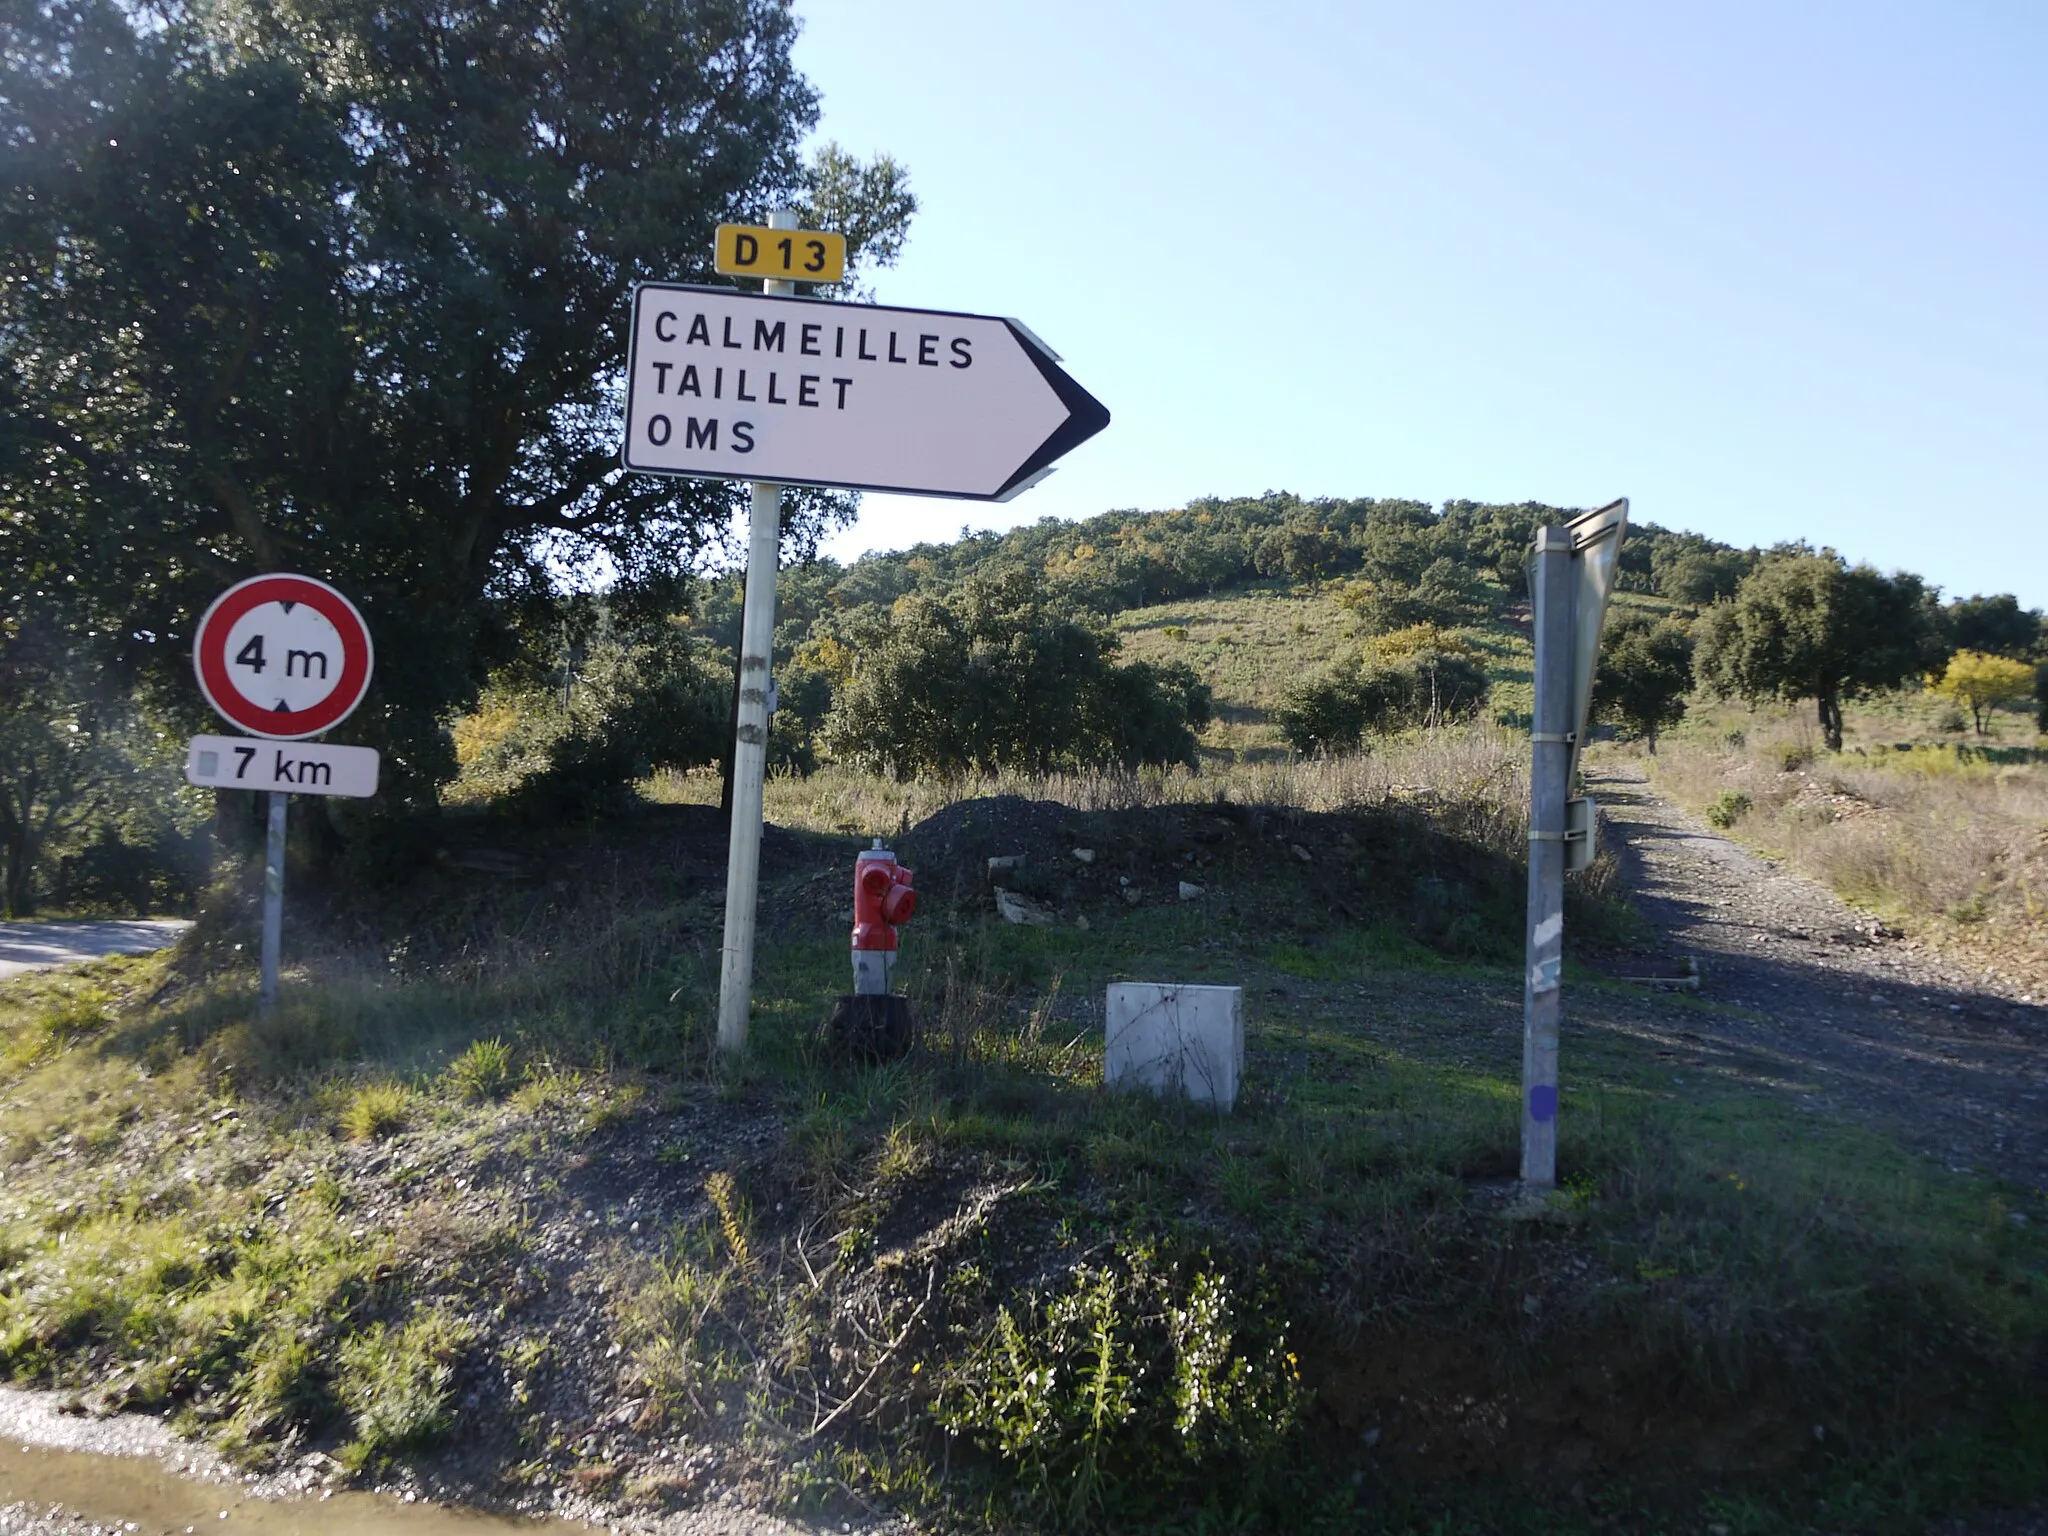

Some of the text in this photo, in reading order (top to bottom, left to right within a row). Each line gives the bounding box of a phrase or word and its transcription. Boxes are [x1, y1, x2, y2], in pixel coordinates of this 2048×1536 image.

[735, 233, 826, 272] D 13
[655, 311, 973, 369] CALMEILLES
[652, 361, 854, 410] TAILLET
[647, 414, 755, 454] OMS
[235, 635, 327, 679] 4 m
[234, 747, 331, 786] 7 km
